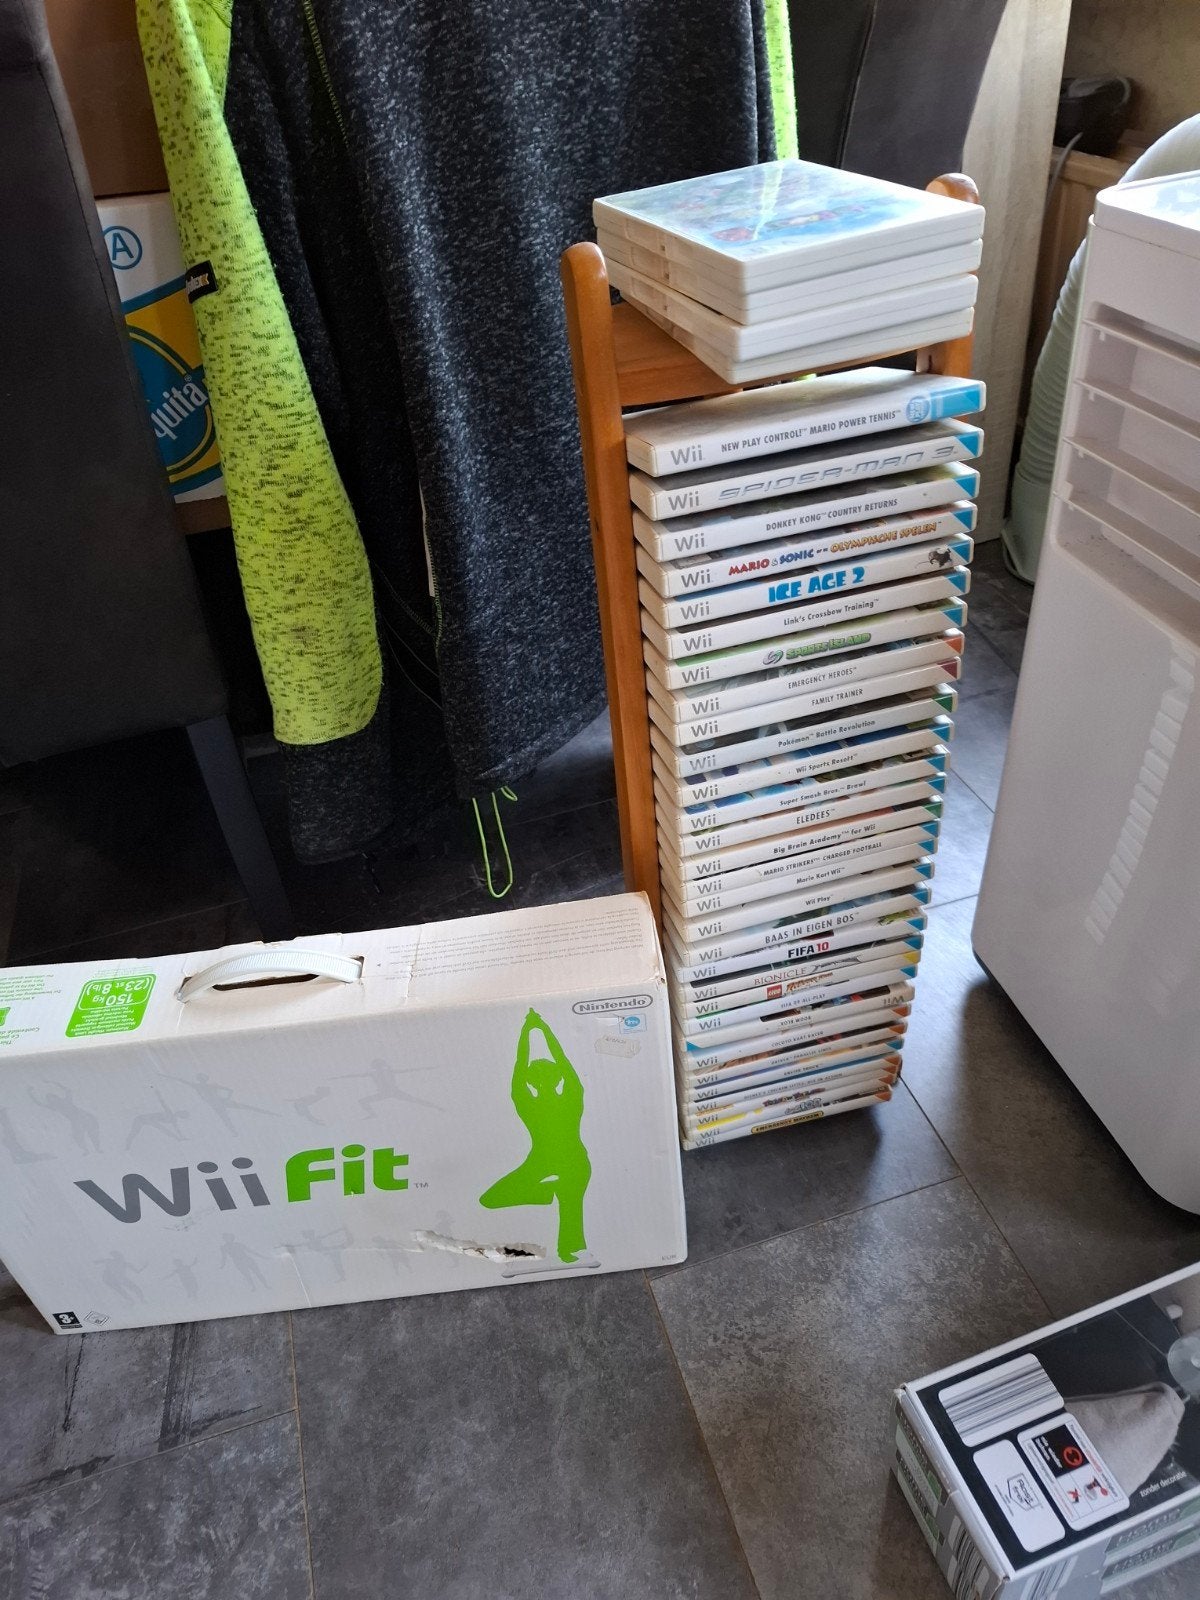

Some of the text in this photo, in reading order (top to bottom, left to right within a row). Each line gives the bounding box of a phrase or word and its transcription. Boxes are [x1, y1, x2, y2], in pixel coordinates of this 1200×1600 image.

[112, 233, 134, 260] A
[721, 441, 740, 453] NEW
[742, 437, 761, 449] PLAY
[809, 422, 836, 435] MARIO
[838, 417, 867, 430] POWER
[670, 444, 703, 466] Wii
[668, 490, 700, 511] Wii
[766, 517, 797, 531] DONKEY
[827, 505, 863, 519] COUNTRY
[864, 499, 898, 512] RETURNS
[674, 533, 705, 552] Wii
[728, 558, 770, 576] MARIO
[779, 549, 814, 565] SONIC
[681, 568, 711, 588] Wii
[768, 566, 865, 603] ICE AGE 2
[681, 601, 710, 620] Wii
[784, 615, 805, 626] Link's
[807, 608, 842, 620] Crossbow
[683, 633, 712, 652] Wii
[682, 666, 711, 684] Wii
[788, 674, 826, 690] EMERGENCY
[692, 697, 720, 715] Wii
[812, 689, 864, 707] FAMILY TRAINER
[691, 720, 719, 738] Wii
[816, 727, 837, 739] Battle
[839, 719, 876, 733] Revolution
[689, 754, 716, 771] Wii
[808, 760, 830, 772] Sports
[692, 784, 719, 801] Wii
[779, 797, 798, 807] Super
[800, 791, 822, 801] Smash
[691, 813, 716, 829] Wii
[797, 810, 830, 825] ELEDEES
[695, 835, 721, 850] Wii
[773, 845, 785, 855] Big
[787, 841, 807, 851] Brain
[696, 860, 721, 875] Wii
[763, 866, 784, 876] MARIO
[823, 850, 851, 861] CHARGED
[697, 880, 722, 894] Wii
[796, 876, 815, 885] Mario
[697, 897, 721, 912] Wii
[698, 922, 722, 937] Wii
[765, 933, 788, 944] BAAS
[793, 927, 803, 937] IN
[806, 920, 833, 933] EIGEN
[699, 947, 722, 961] Wii
[788, 941, 830, 958] FIFA 10
[693, 966, 716, 979] Wii
[754, 967, 807, 985] BIONICLE
[694, 987, 718, 1000] Wii
[579, 998, 646, 1012] Nintendo
[696, 1001, 719, 1014] Wii
[699, 1017, 721, 1031] Wii
[697, 1056, 718, 1068] Wii
[697, 1074, 718, 1084] Wii
[697, 1089, 718, 1099] Wii
[697, 1102, 717, 1111] Wii
[698, 1115, 718, 1124] Wii
[700, 1129, 720, 1139] Wii
[73, 1156, 271, 1223] Wii
[285, 1144, 410, 1203] Fit
